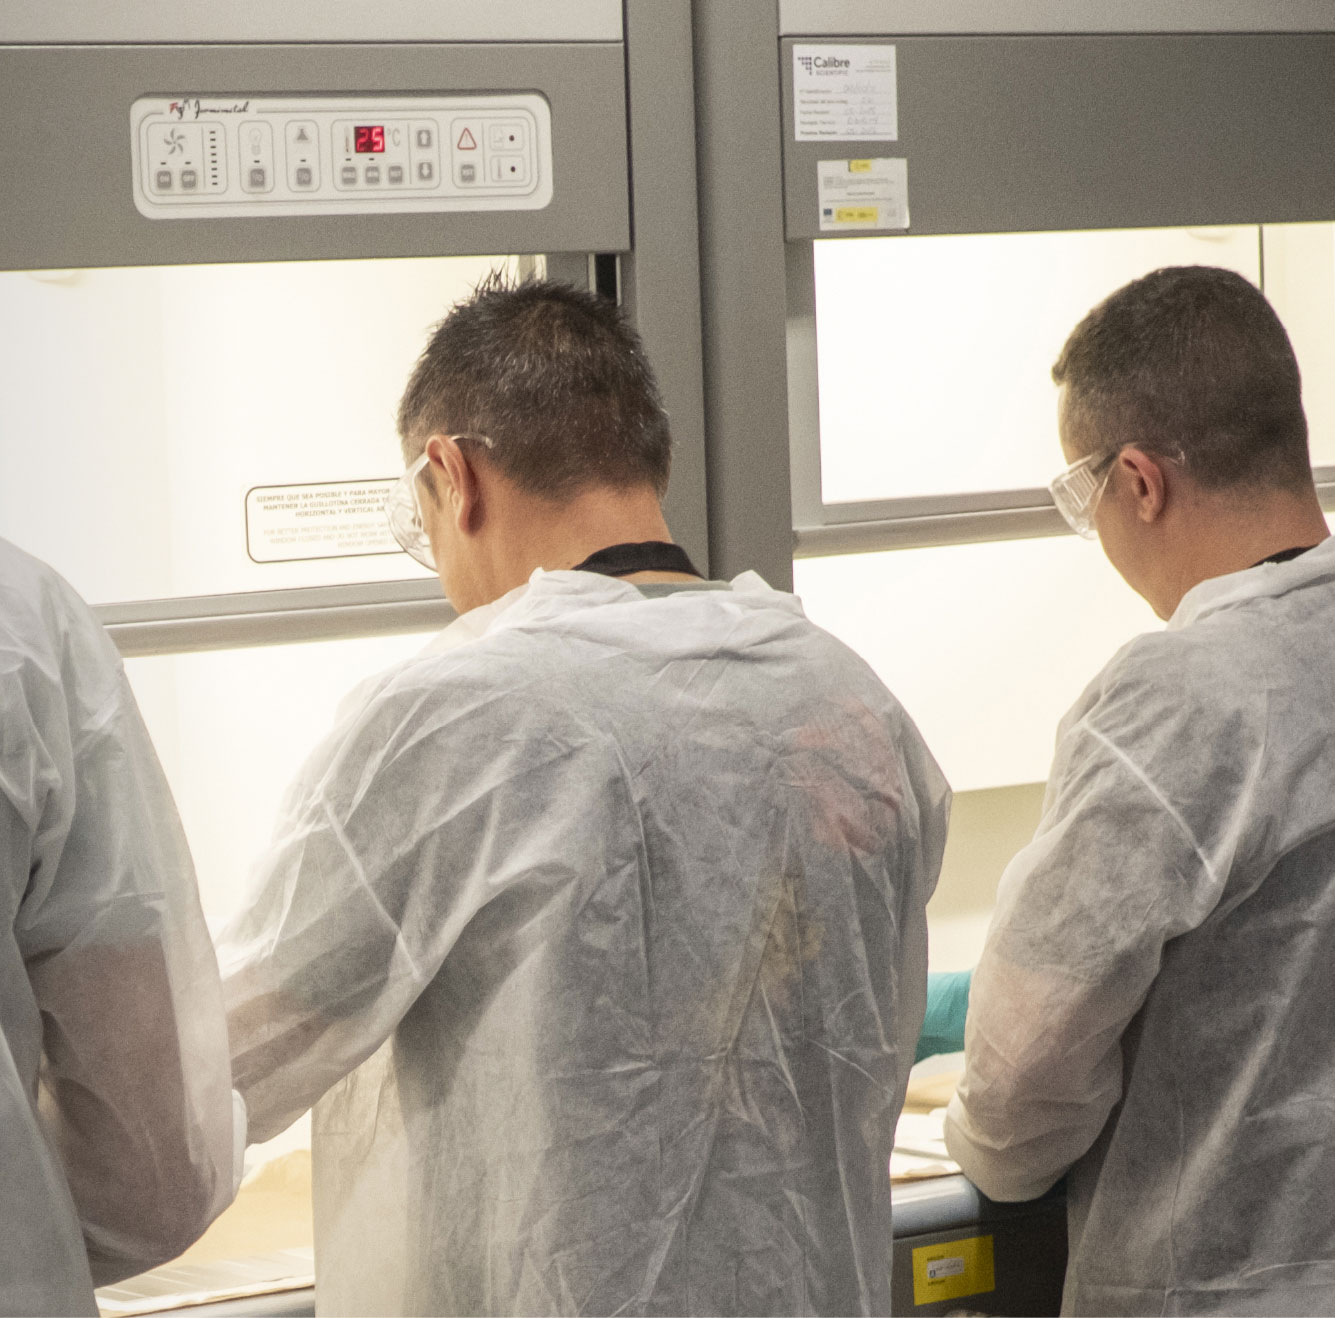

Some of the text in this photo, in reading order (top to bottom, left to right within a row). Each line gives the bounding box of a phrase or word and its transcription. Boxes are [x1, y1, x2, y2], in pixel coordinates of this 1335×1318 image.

[813, 56, 850, 68] Calibre
[357, 128, 383, 151] 25
[256, 494, 285, 503] SIEMPRE
[286, 493, 300, 501] QUE
[315, 490, 342, 499] POSIBLE
[349, 489, 366, 497] PARA
[368, 488, 390, 496] MAYOR
[263, 502, 299, 511] MANTENER
[301, 501, 308, 509] LA
[350, 497, 380, 506] CERRADA
[295, 508, 337, 518] HORIZONTAL
[344, 506, 374, 515] VERTICAL
